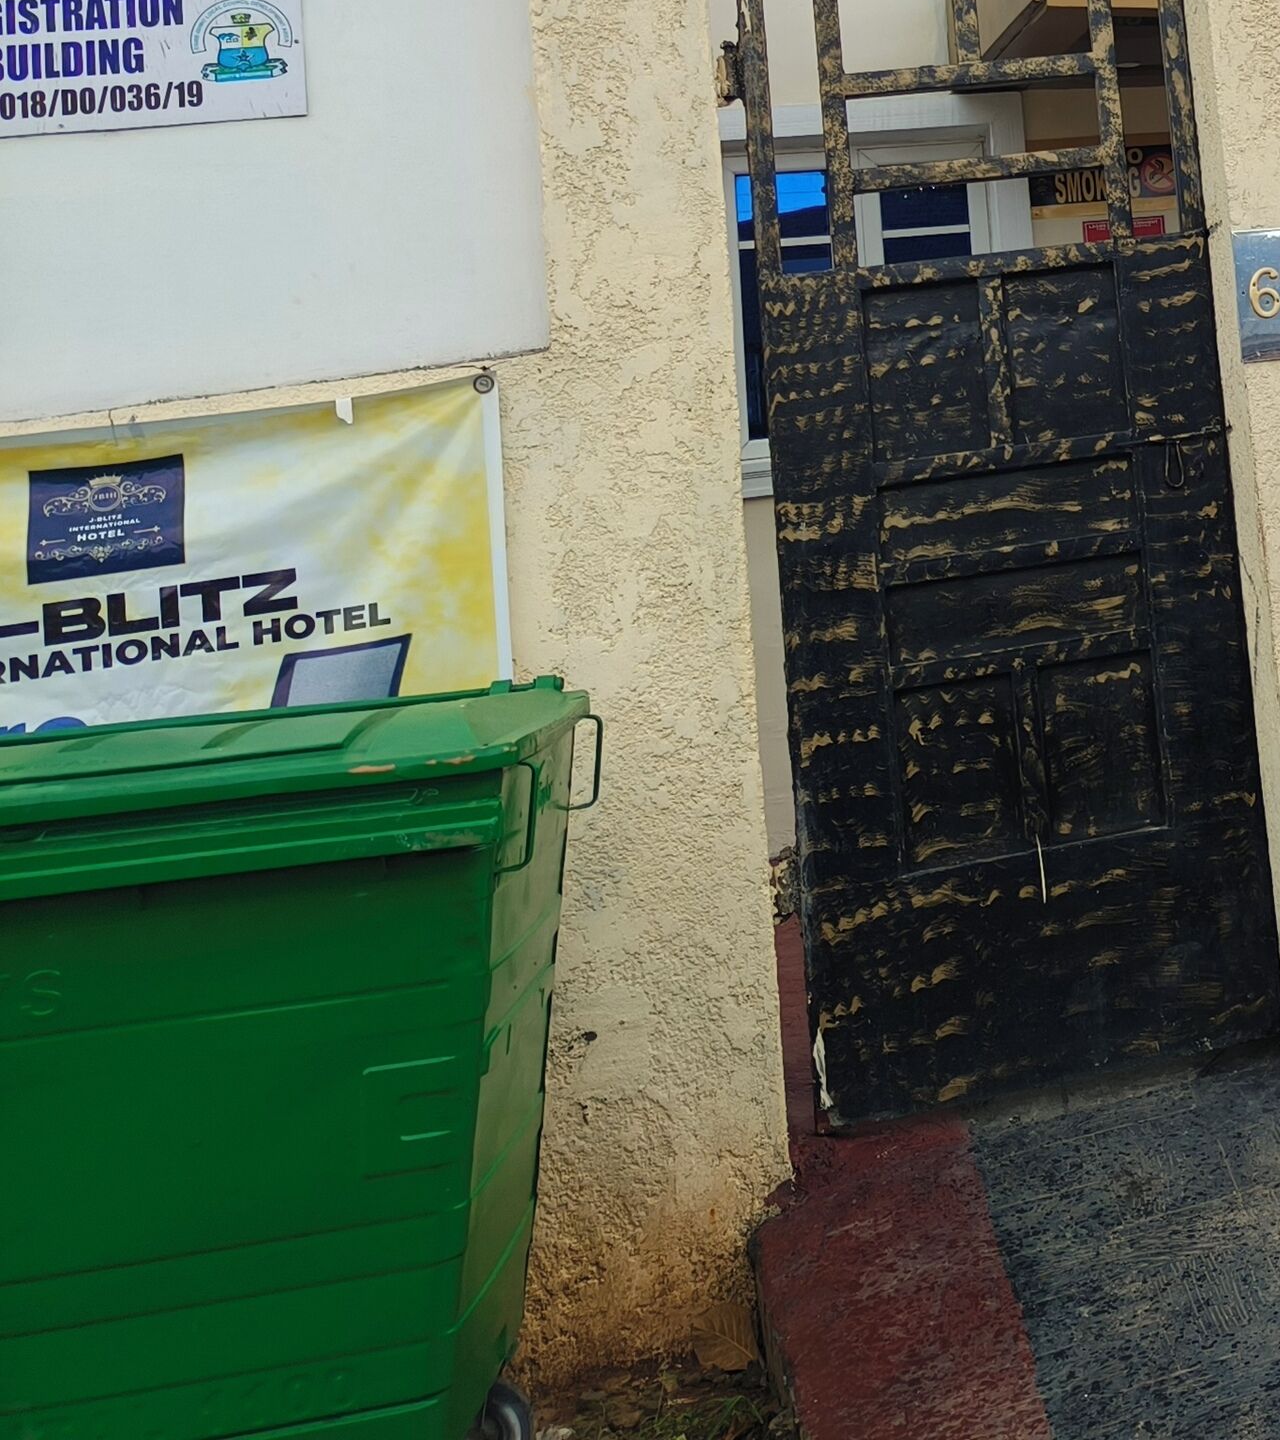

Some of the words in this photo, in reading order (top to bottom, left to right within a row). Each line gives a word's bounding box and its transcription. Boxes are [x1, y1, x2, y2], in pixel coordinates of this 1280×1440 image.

[0, 37, 145, 81] UILDING
[1055, 166, 1141, 204] SMOKG
[69, 518, 141, 533] INTERNATIONAL
[77, 529, 125, 542] HOTEL
[252, 602, 392, 646] HOTEL
